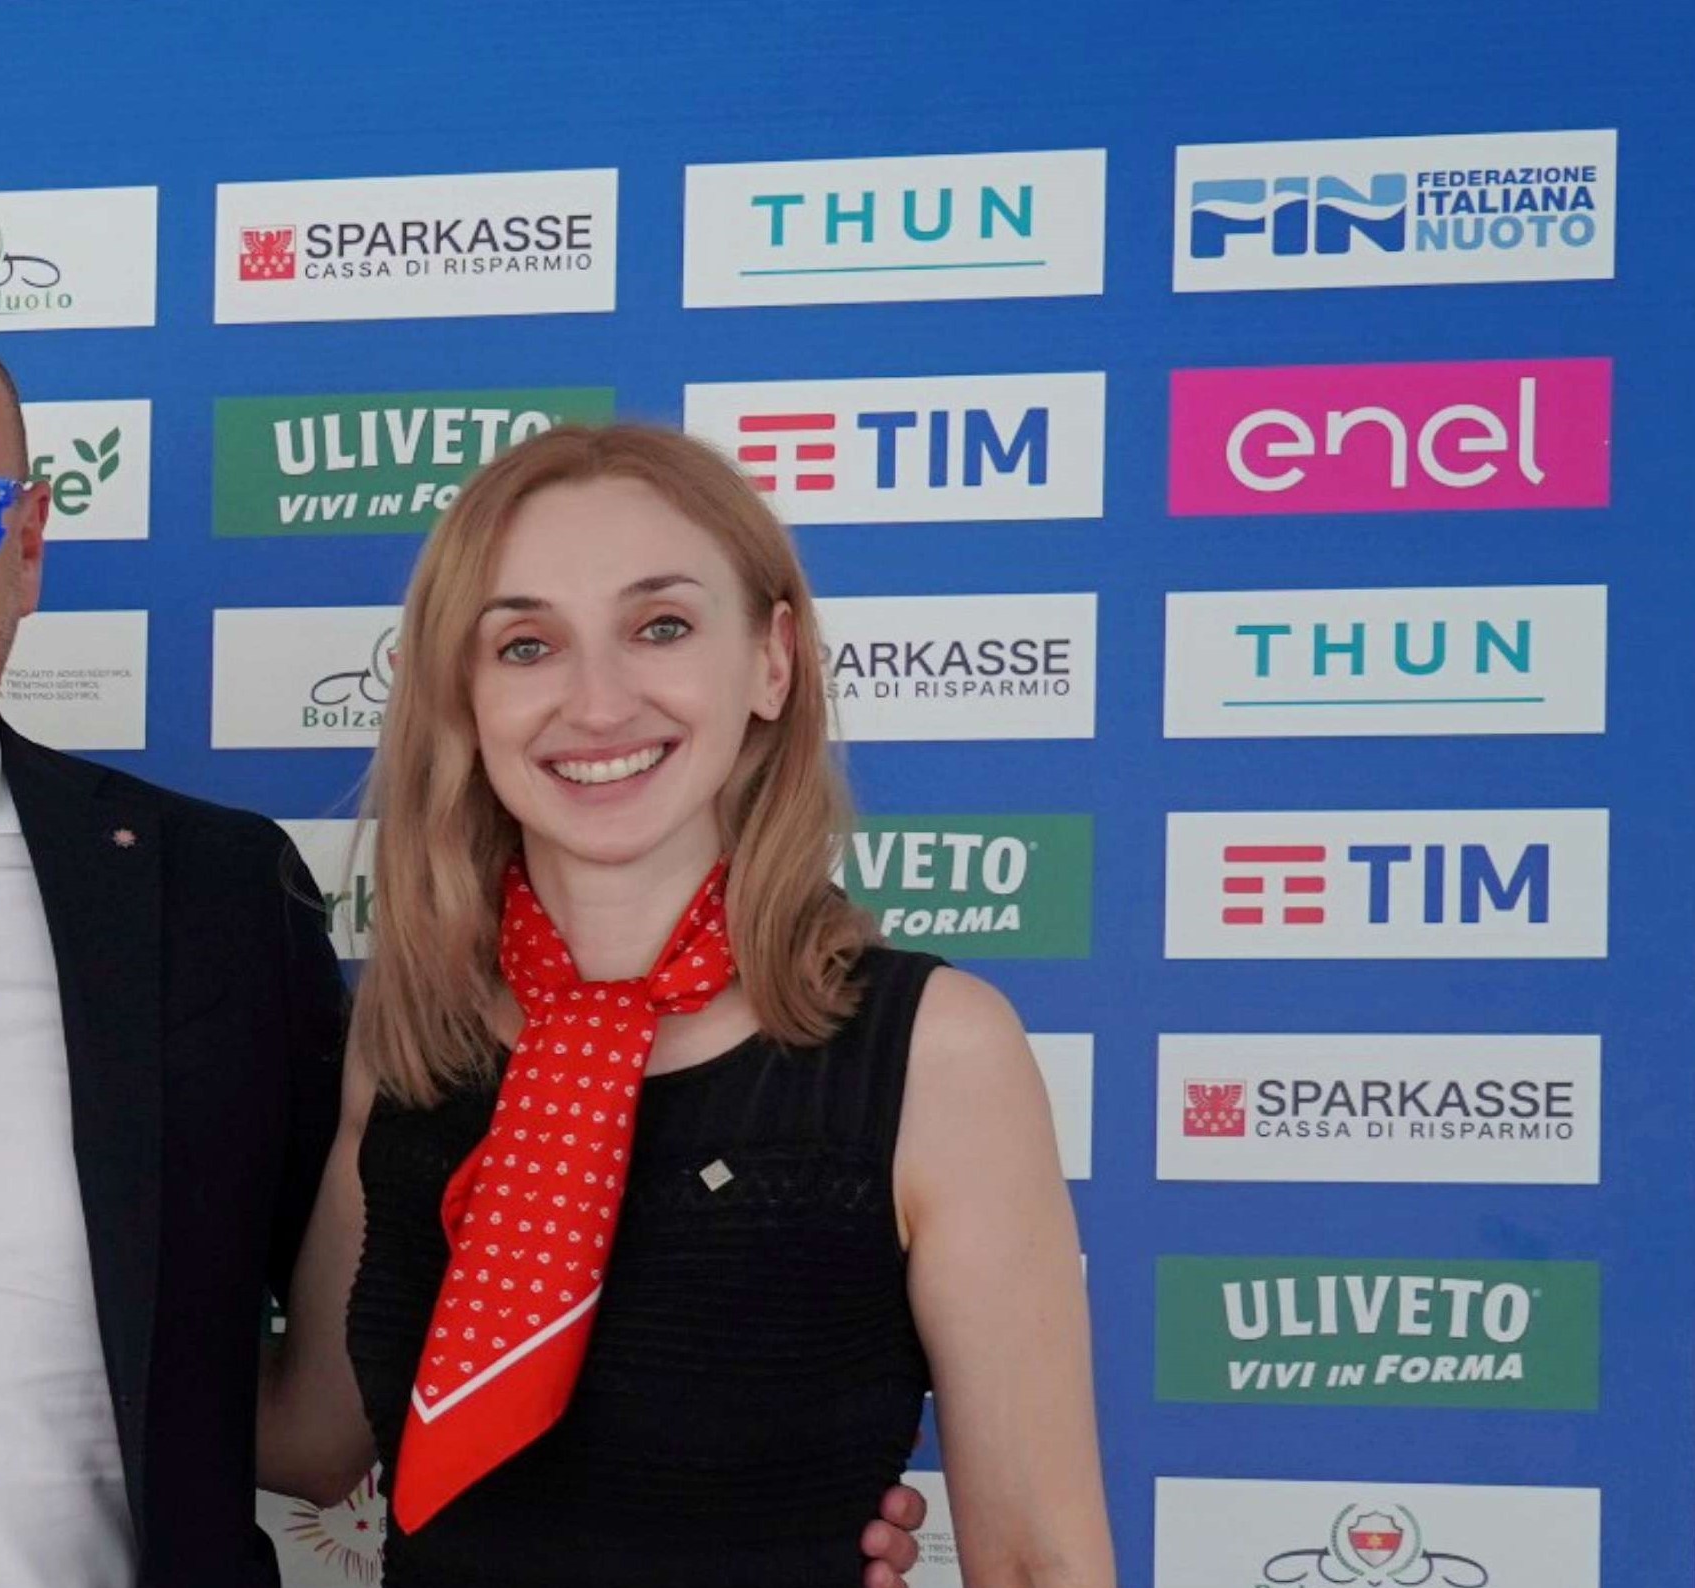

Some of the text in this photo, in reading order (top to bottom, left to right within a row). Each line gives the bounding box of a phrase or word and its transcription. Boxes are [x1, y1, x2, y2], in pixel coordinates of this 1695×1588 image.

[1417, 165, 1597, 188] FEDERAZIONE
[751, 184, 1034, 247] THUN
[1190, 173, 1407, 259] FIN
[1416, 185, 1596, 217] ITALIANA
[306, 214, 593, 259] SPARKASSE
[1415, 212, 1596, 252] NUOTO
[304, 253, 593, 280] CASSA DI RISPARMIO
[857, 407, 1049, 489] TIM
[1226, 377, 1545, 492] enel
[279, 492, 356, 524] VIVI
[1235, 619, 1531, 678] THUN
[875, 681, 899, 699] DI
[915, 678, 1071, 698] RISPARMIO
[1348, 843, 1550, 924] TIM
[880, 903, 1021, 937] FORMA
[1256, 1079, 1574, 1118] SPARKASSE
[1255, 1120, 1574, 1140] CASSA DI RISPARMIO
[1222, 1275, 1531, 1344] ULIVETO
[1227, 1360, 1316, 1390] VIVI
[1374, 1353, 1524, 1385] FORMA
